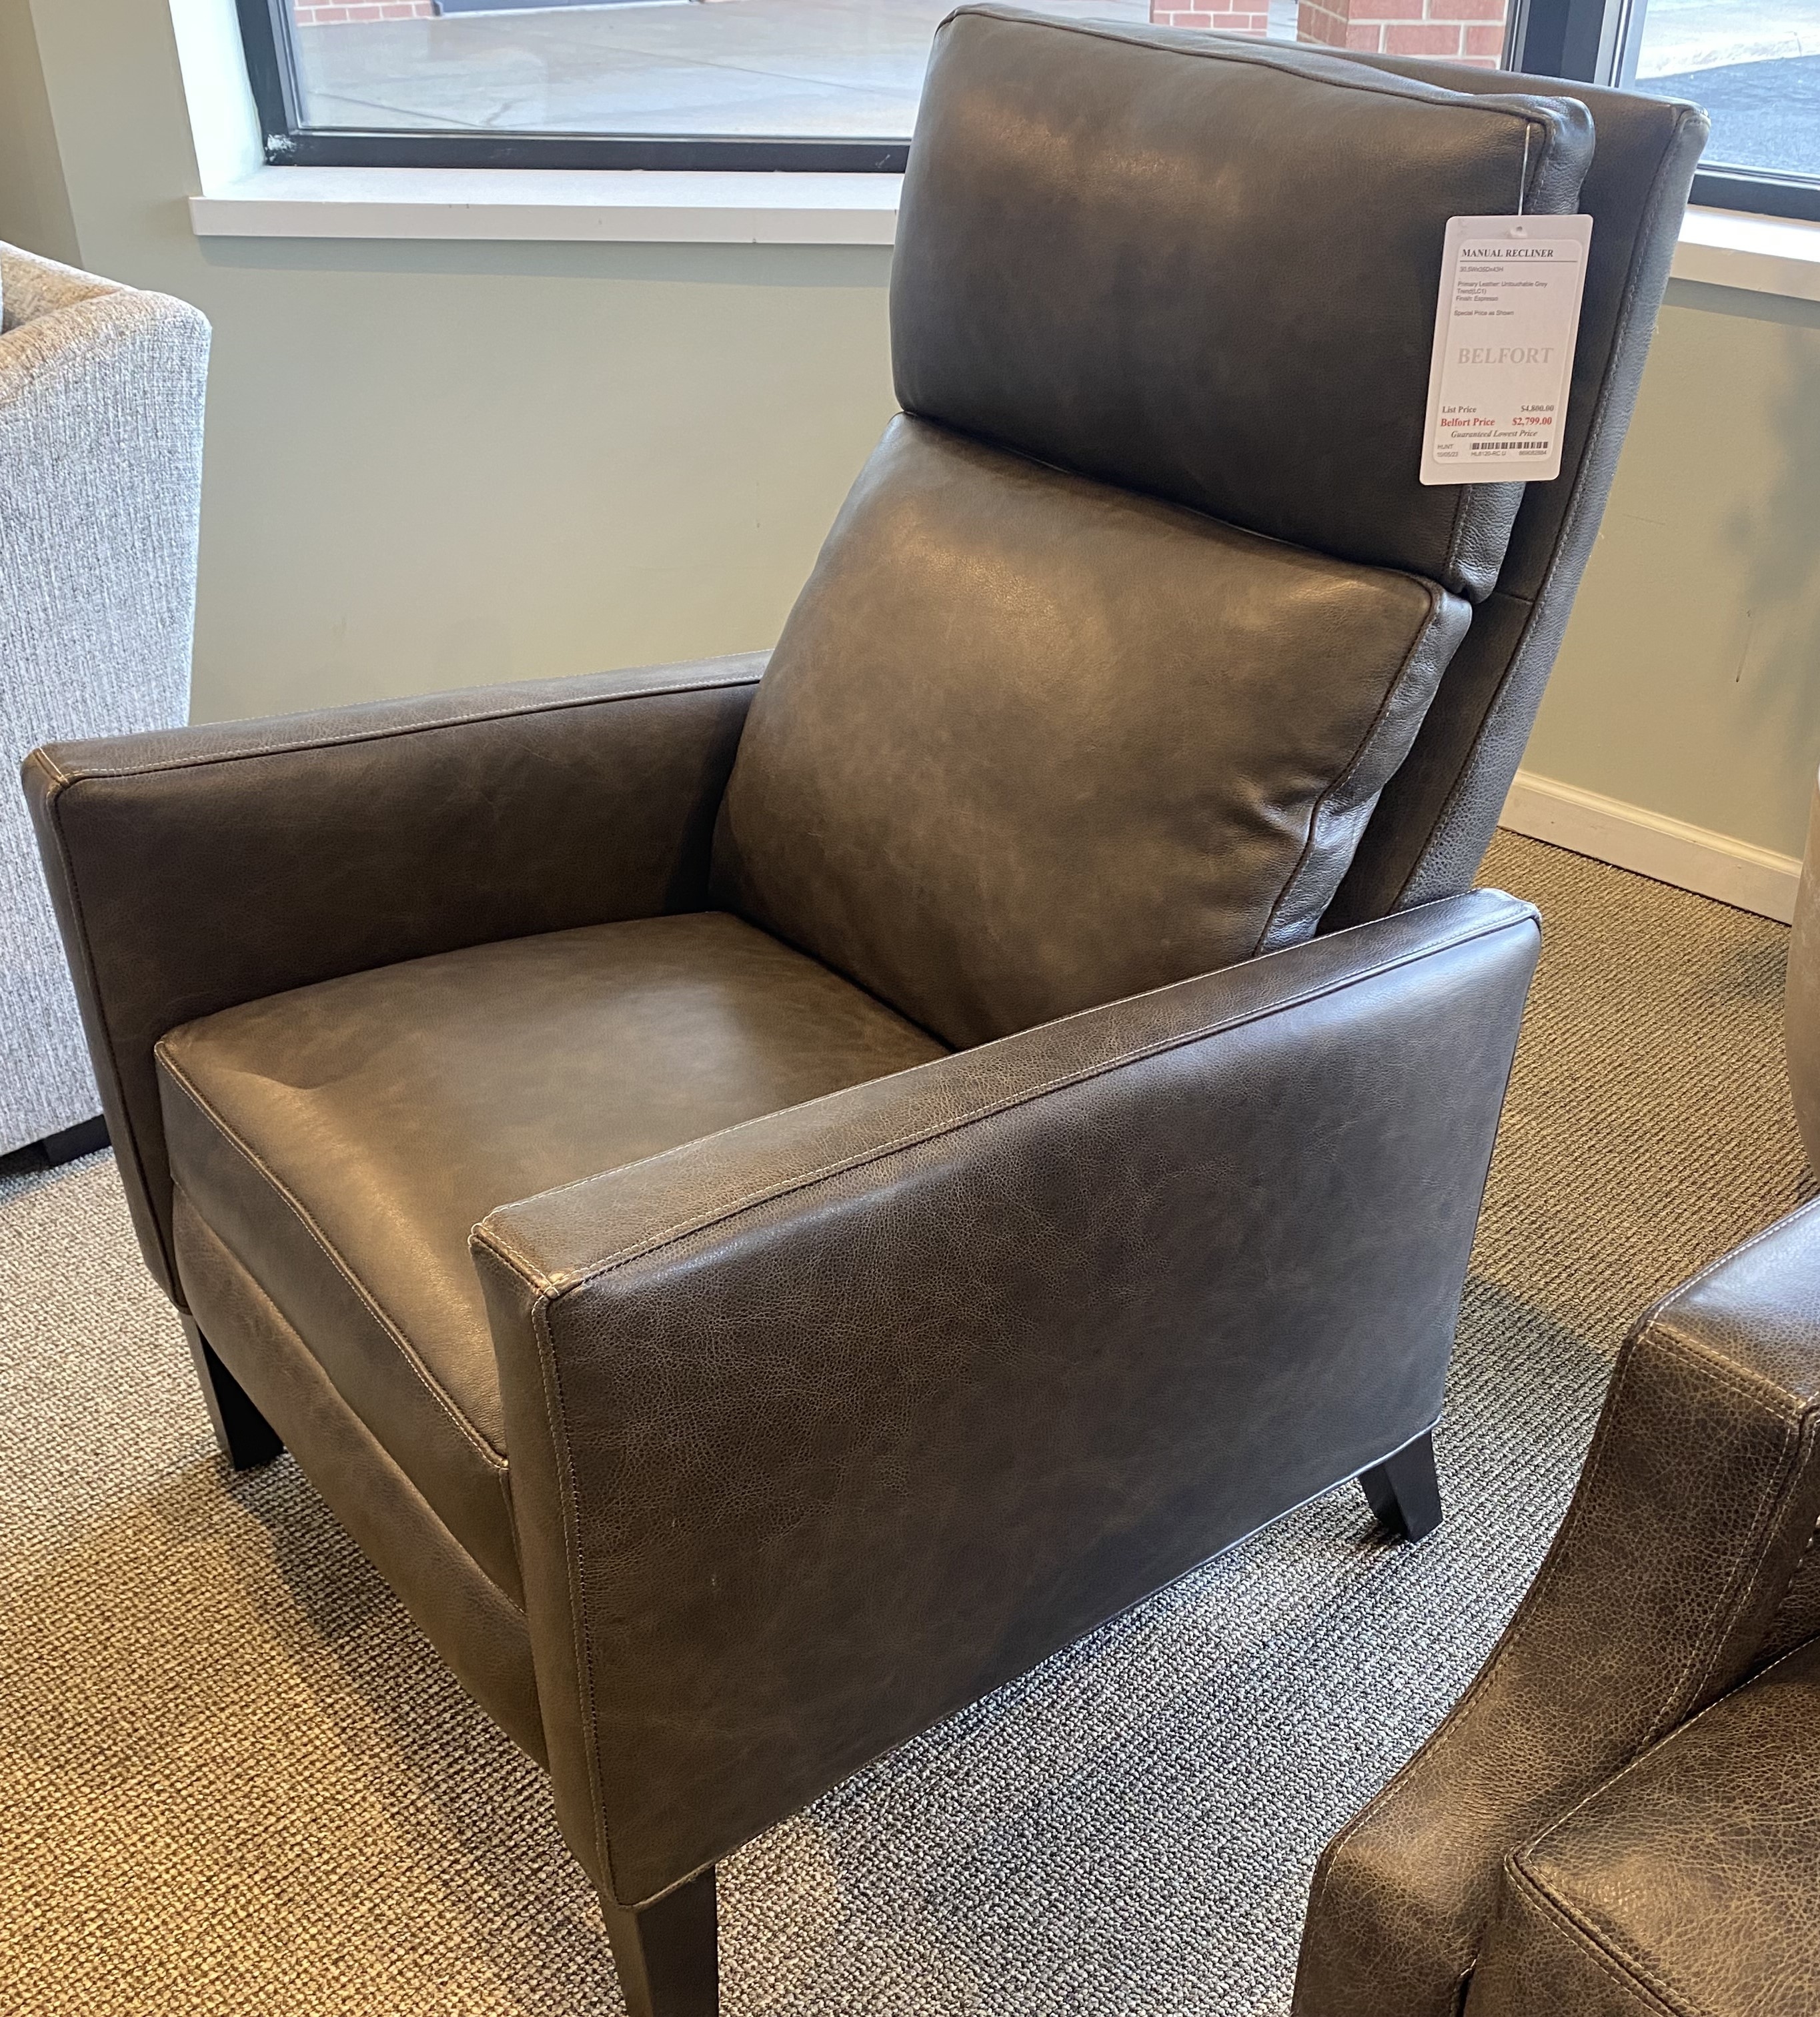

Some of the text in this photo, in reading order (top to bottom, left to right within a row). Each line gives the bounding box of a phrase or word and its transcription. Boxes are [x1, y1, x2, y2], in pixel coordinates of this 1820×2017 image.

[1462, 249, 1554, 257] MANUAL RECLINER
[1457, 347, 1555, 365] BELFORT
[1442, 406, 1477, 414] List Price
[1441, 417, 1495, 427] Belfort Price
[1512, 417, 1553, 427] $2,799.00
[1451, 430, 1491, 438] Guaranteed
